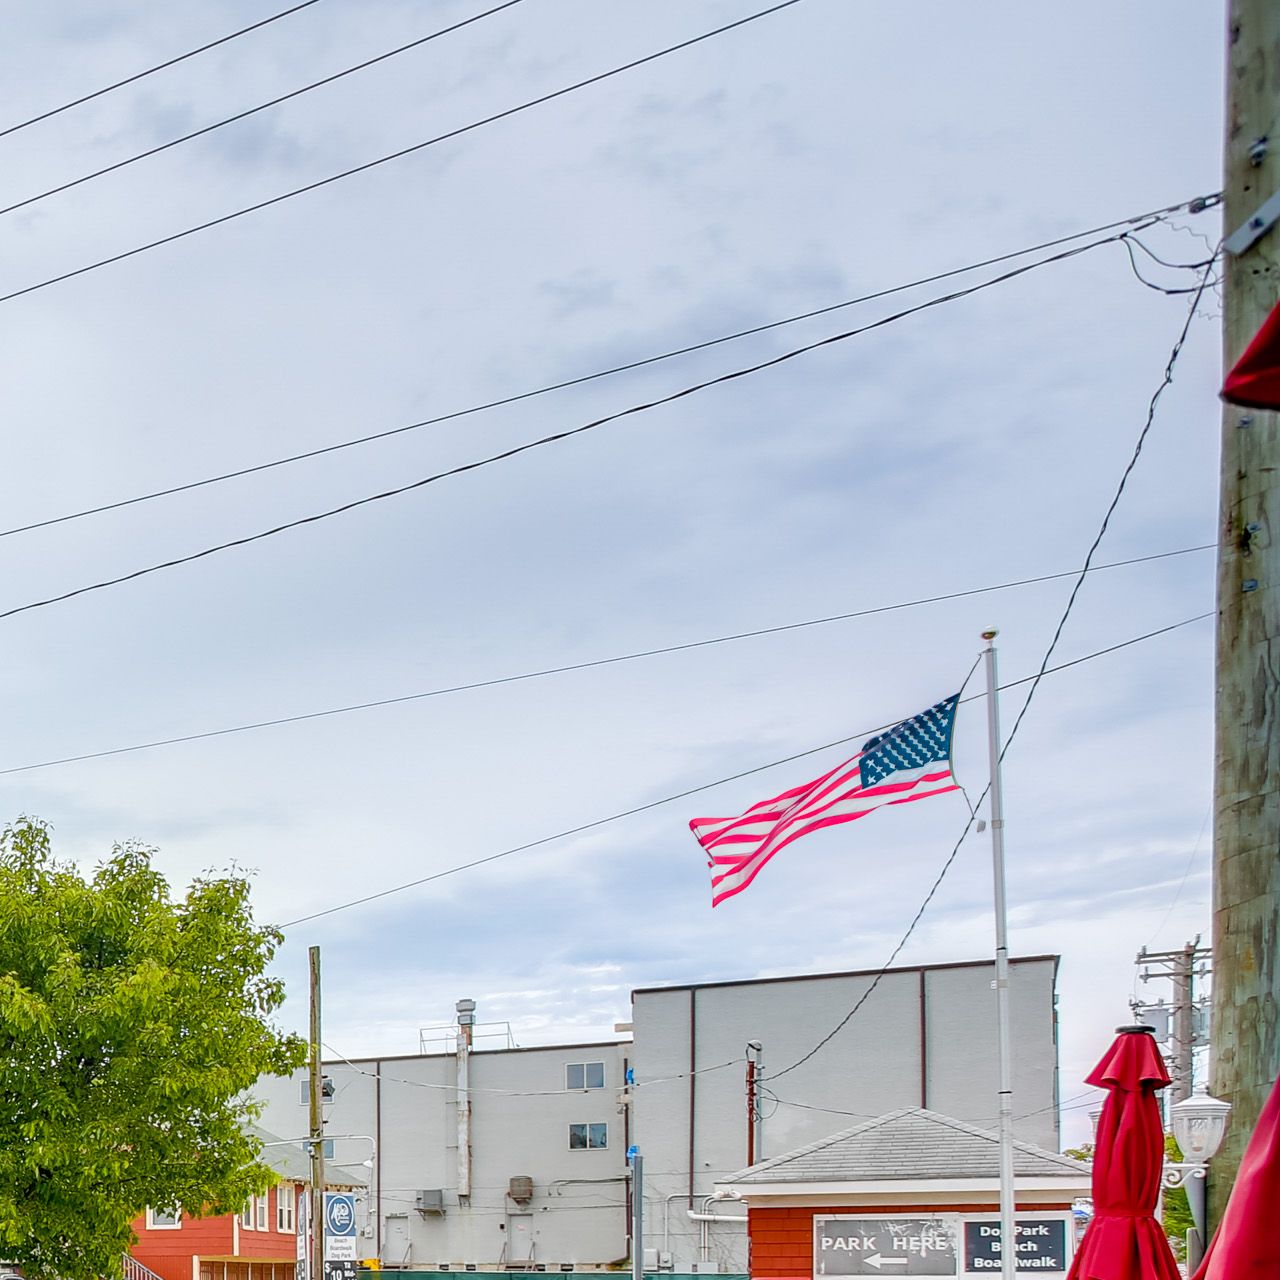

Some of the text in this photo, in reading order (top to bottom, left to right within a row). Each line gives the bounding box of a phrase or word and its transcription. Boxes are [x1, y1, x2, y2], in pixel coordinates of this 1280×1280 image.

[1014, 1225, 1049, 1236] Park
[821, 1237, 947, 1250] PARK HERE
[991, 1241, 1037, 1252] Bch
[974, 1257, 1056, 1268] Boawalk
